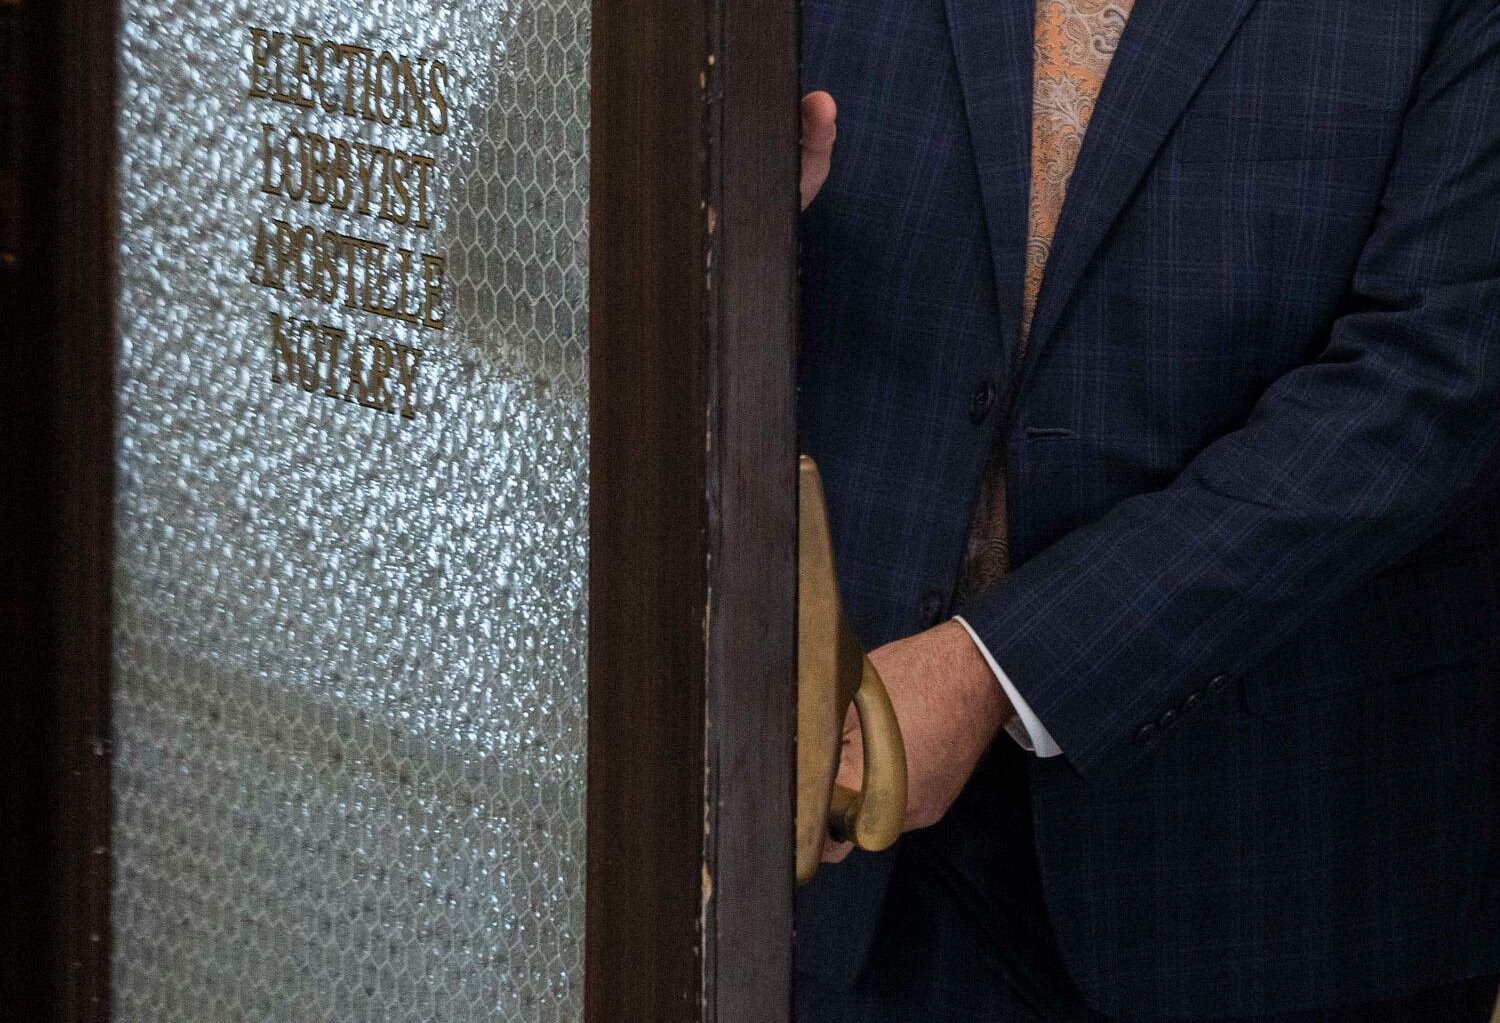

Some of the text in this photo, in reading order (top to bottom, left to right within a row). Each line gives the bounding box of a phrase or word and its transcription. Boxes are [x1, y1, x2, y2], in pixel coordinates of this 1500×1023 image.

[249, 27, 448, 136] ELECTIONS
[262, 124, 435, 230] LOBBYIST
[249, 220, 446, 330] APOSTILLE
[272, 312, 423, 419] NOTARY
